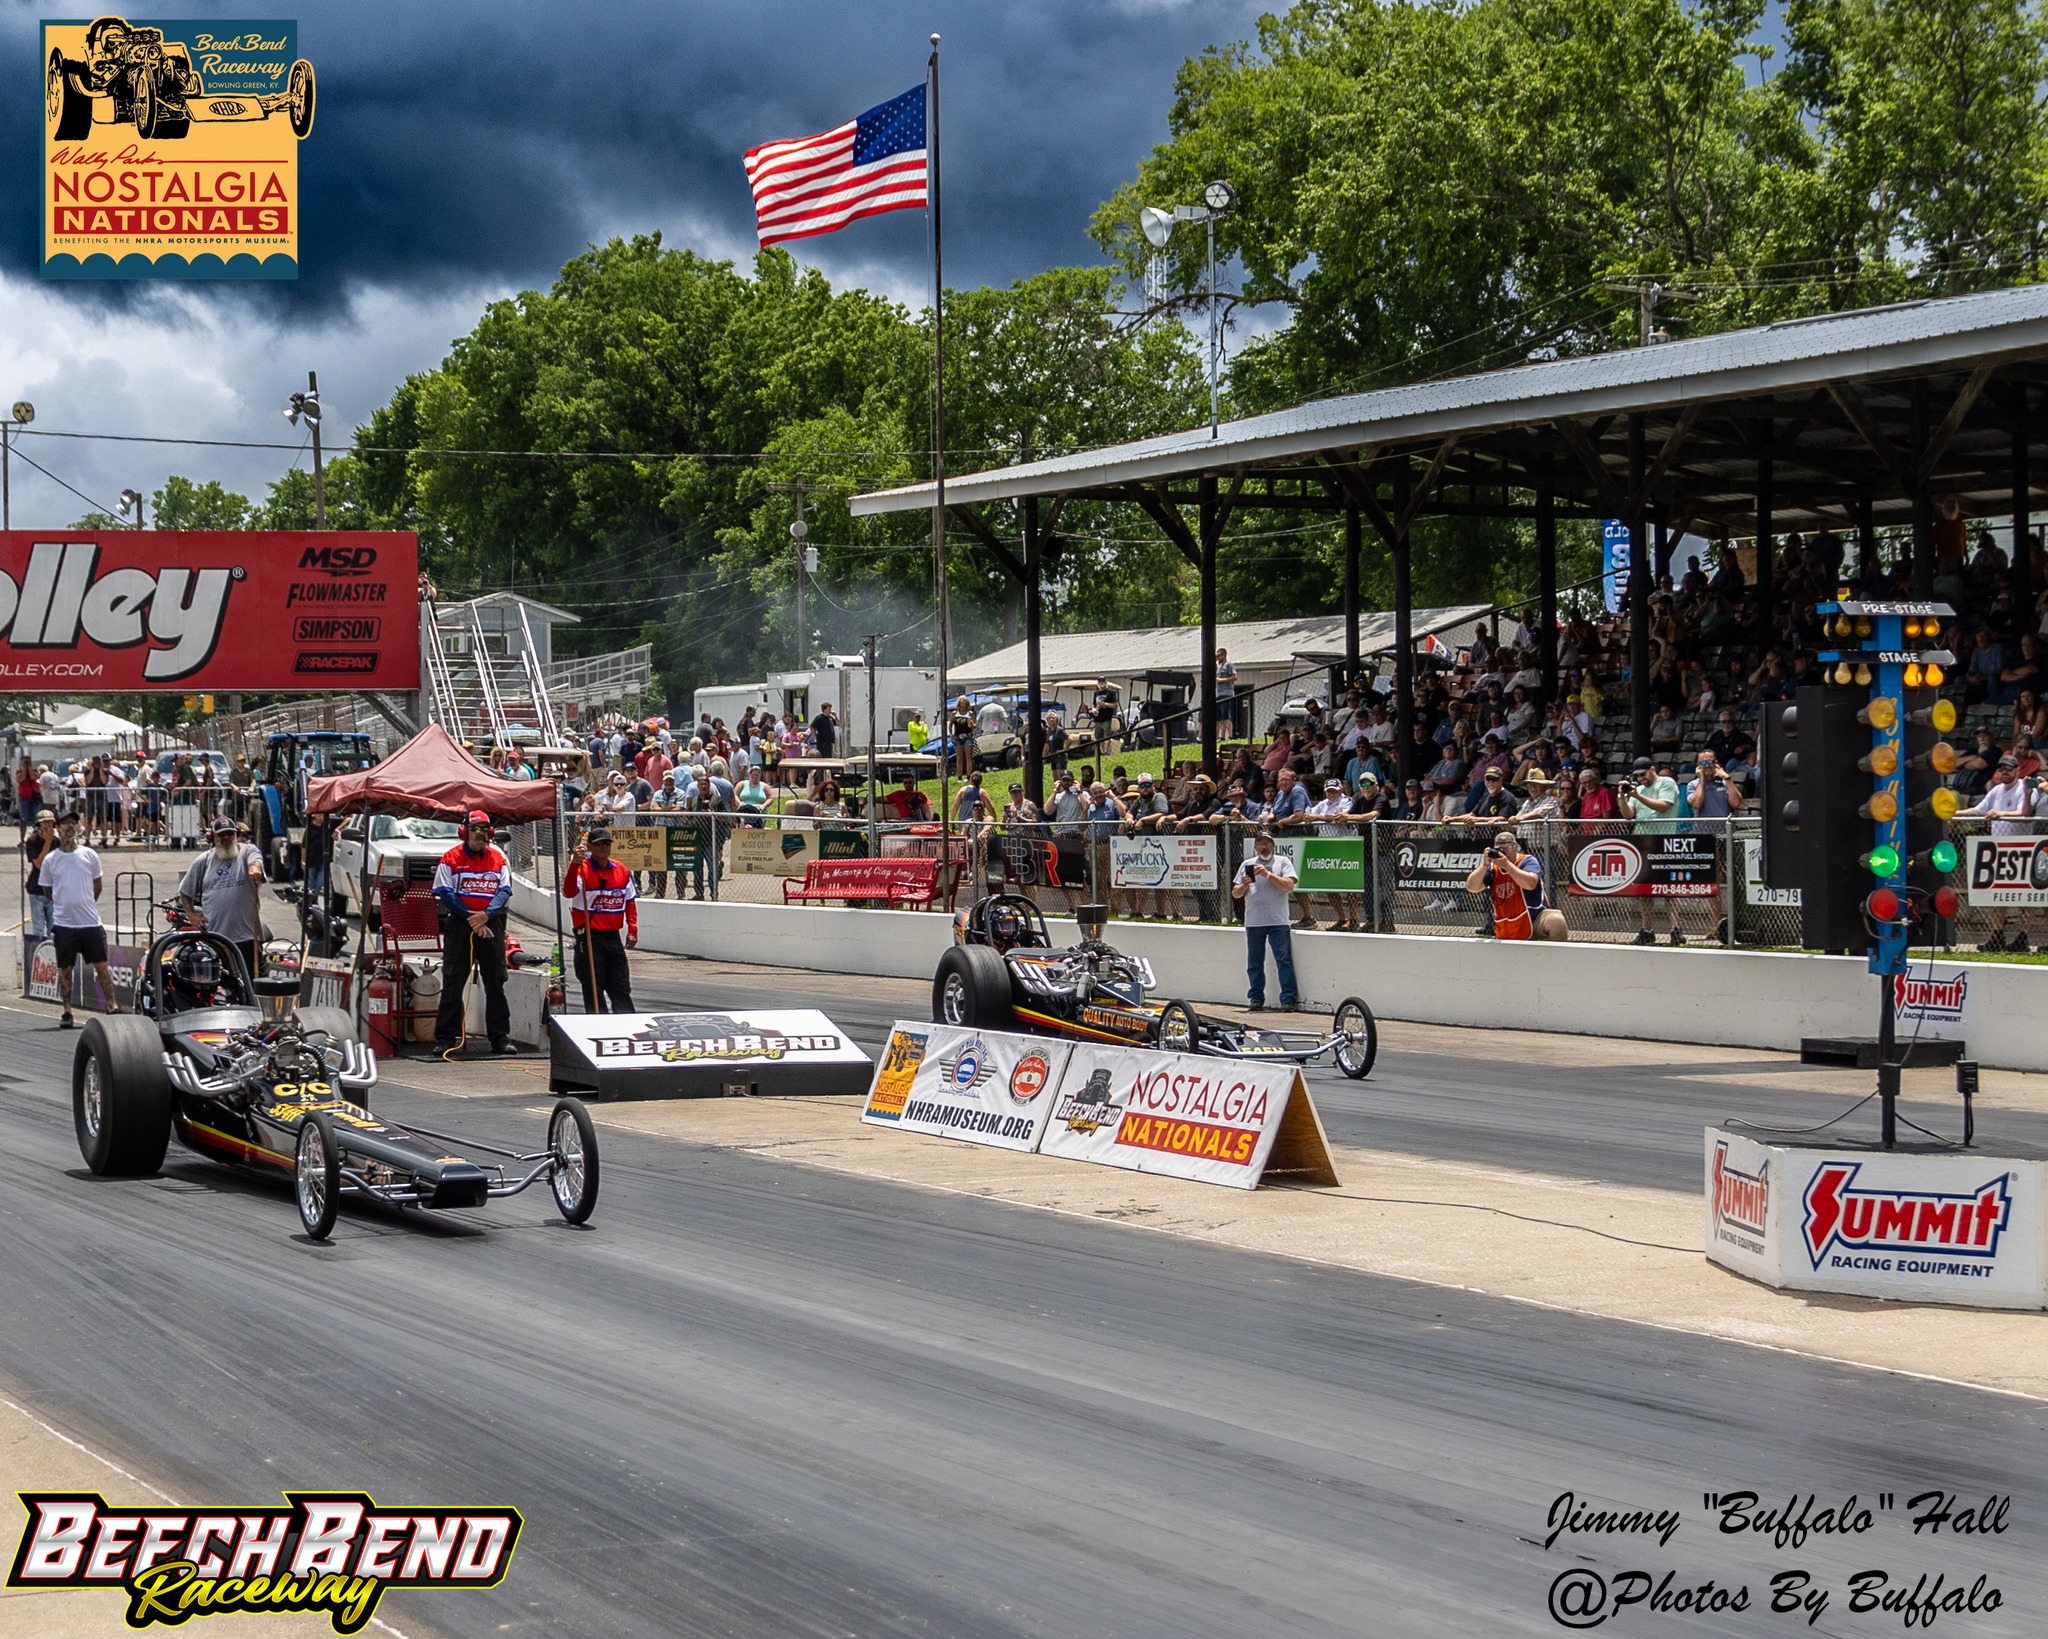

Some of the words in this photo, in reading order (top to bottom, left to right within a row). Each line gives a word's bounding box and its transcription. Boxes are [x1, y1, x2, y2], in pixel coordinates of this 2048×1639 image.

[298, 547, 377, 568] MSD
[286, 583, 387, 609] FLOWMASTER
[0, 543, 233, 681] lley
[1861, 603, 1936, 614] PRE-STAGE
[298, 620, 375, 639] SIMPSON
[310, 656, 372, 668] RACEPAK
[1878, 652, 1920, 662] STAGE
[636, 829, 647, 839] THE
[747, 831, 766, 839] DON'T
[824, 841, 856, 853] Mint
[1663, 838, 1696, 852] NEXT
[1019, 838, 1062, 887] BTR
[1115, 853, 1166, 865] KENTUCKY
[1306, 858, 1360, 870] VisitBGKY.com
[1587, 850, 1627, 876] ATM
[822, 870, 830, 879] In
[831, 868, 862, 880] Memory
[863, 866, 873, 879] of
[874, 866, 892, 880] Clay
[893, 867, 915, 881] Jones
[1398, 880, 1417, 888] RACE
[1418, 880, 1441, 888] FUELS
[1651, 884, 1712, 894] 270-846-3964
[1993, 893, 2022, 902] FLEET
[2027, 893, 2048, 902] SER
[1082, 1007, 1115, 1027] QUALITY
[1115, 1015, 1132, 1029] AUTO
[1132, 1018, 1148, 1032] BODY
[1927, 1014, 1961, 1022] EQUIPMENT
[600, 1038, 728, 1055] BEECH
[730, 1036, 835, 1051] BEND
[662, 1047, 782, 1061] Raceway
[1128, 1070, 1269, 1126] NOSTALGIA
[904, 1100, 1035, 1140] NHRAMUSEUM.ORG
[1120, 1116, 1253, 1161] NATIONALS
[1720, 1229, 1737, 1246] RACING
[1737, 1235, 1766, 1256] EQUIPMENT
[1831, 1255, 1892, 1271] RACING
[1896, 1259, 1994, 1277] EQUIPMENT
